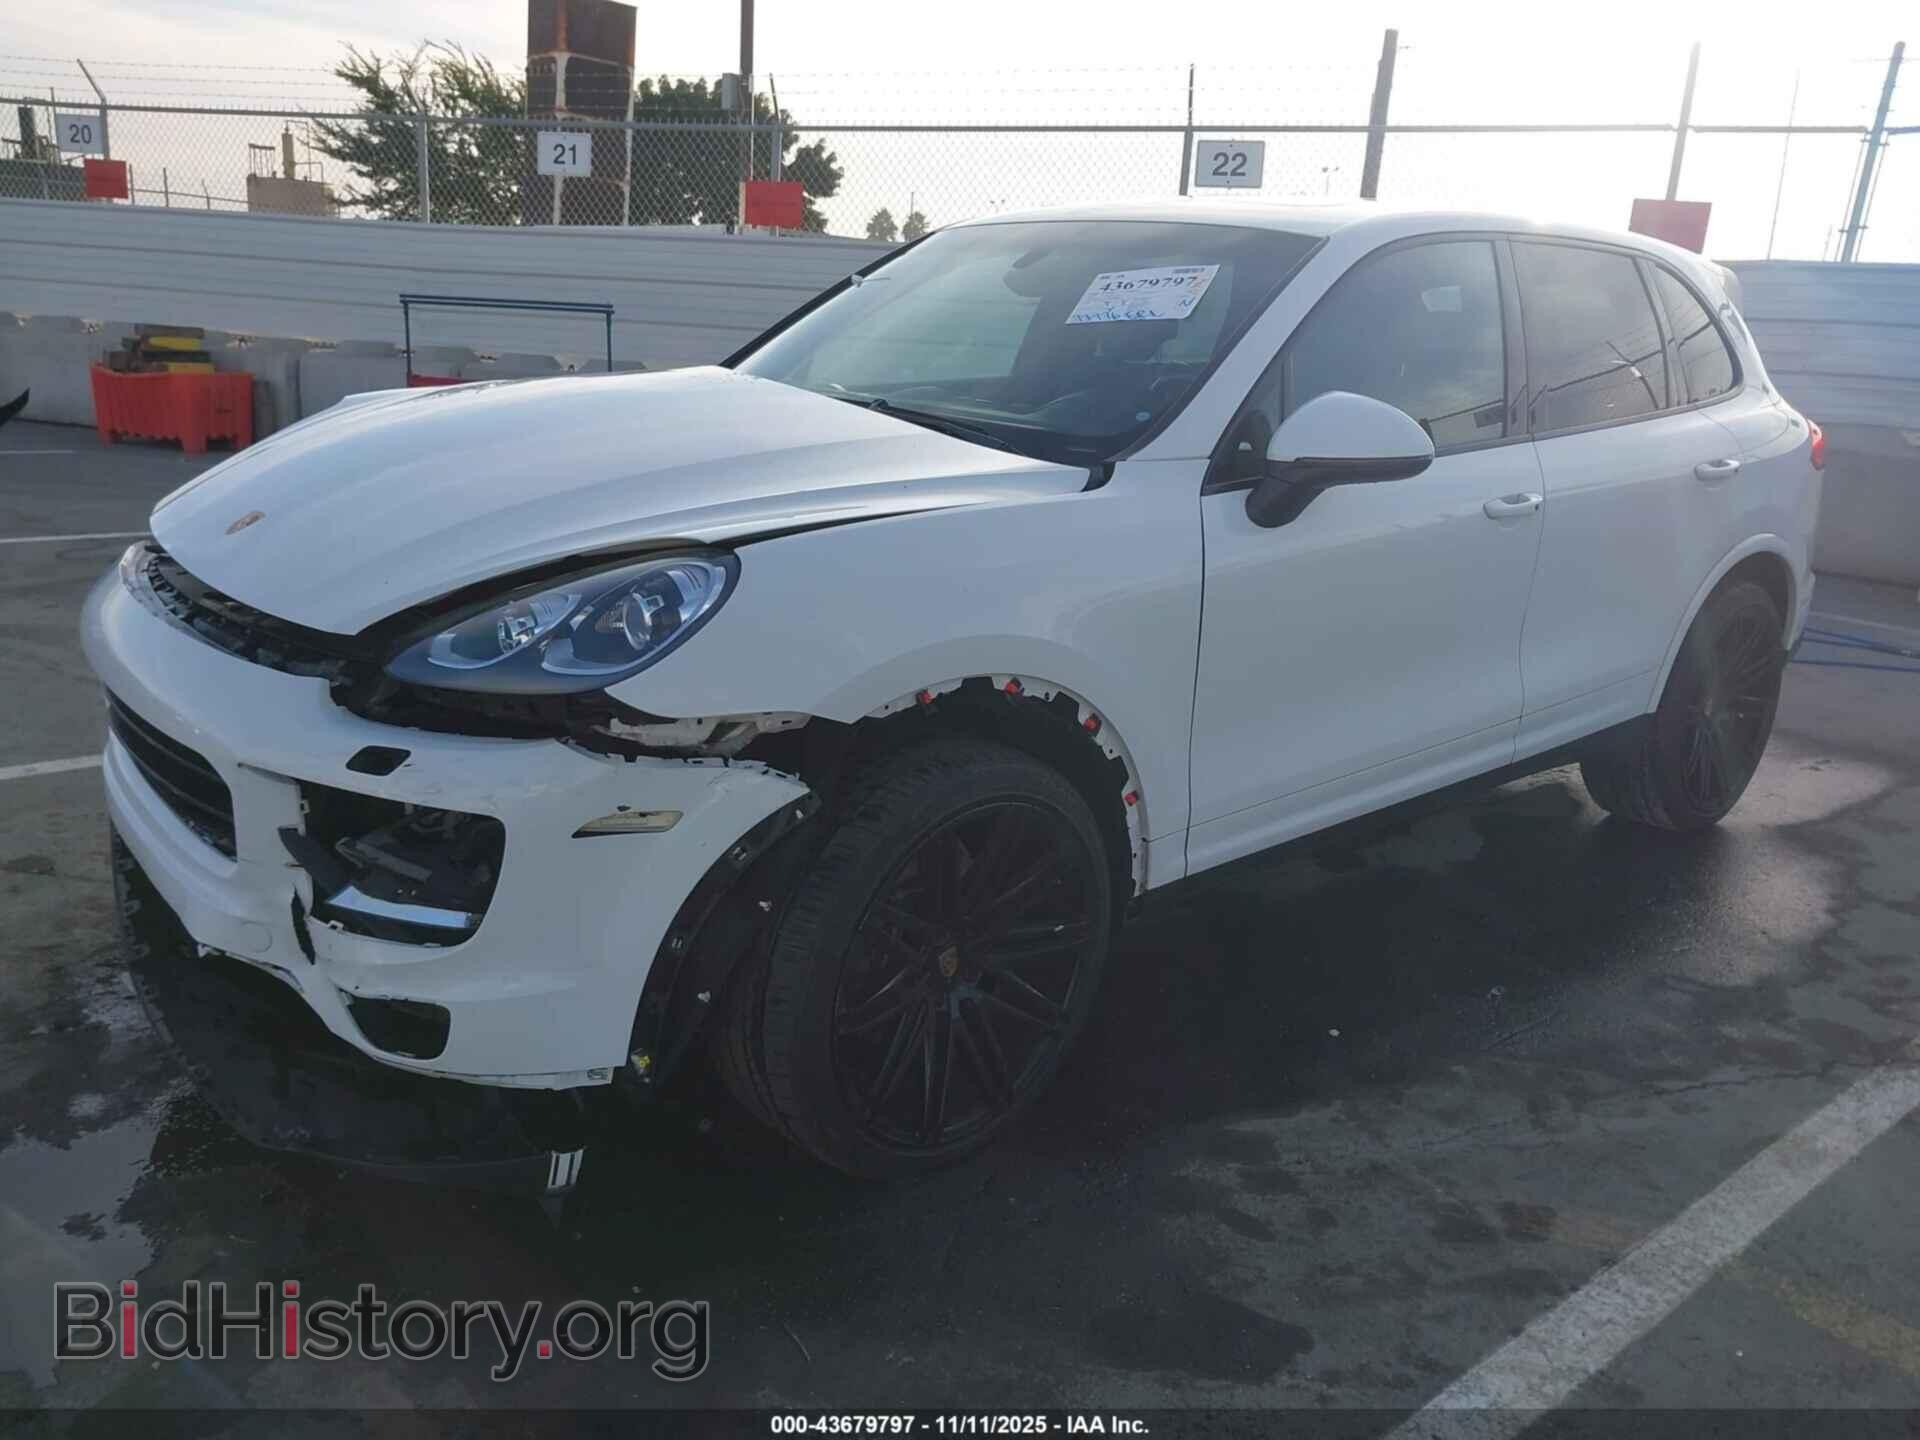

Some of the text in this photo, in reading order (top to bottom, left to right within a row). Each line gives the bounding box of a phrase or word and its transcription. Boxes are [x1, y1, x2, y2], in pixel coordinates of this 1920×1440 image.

[69, 123, 92, 144] 20
[553, 144, 577, 165] 21
[1212, 151, 1248, 176] 22
[1099, 275, 1198, 293] 43679797
